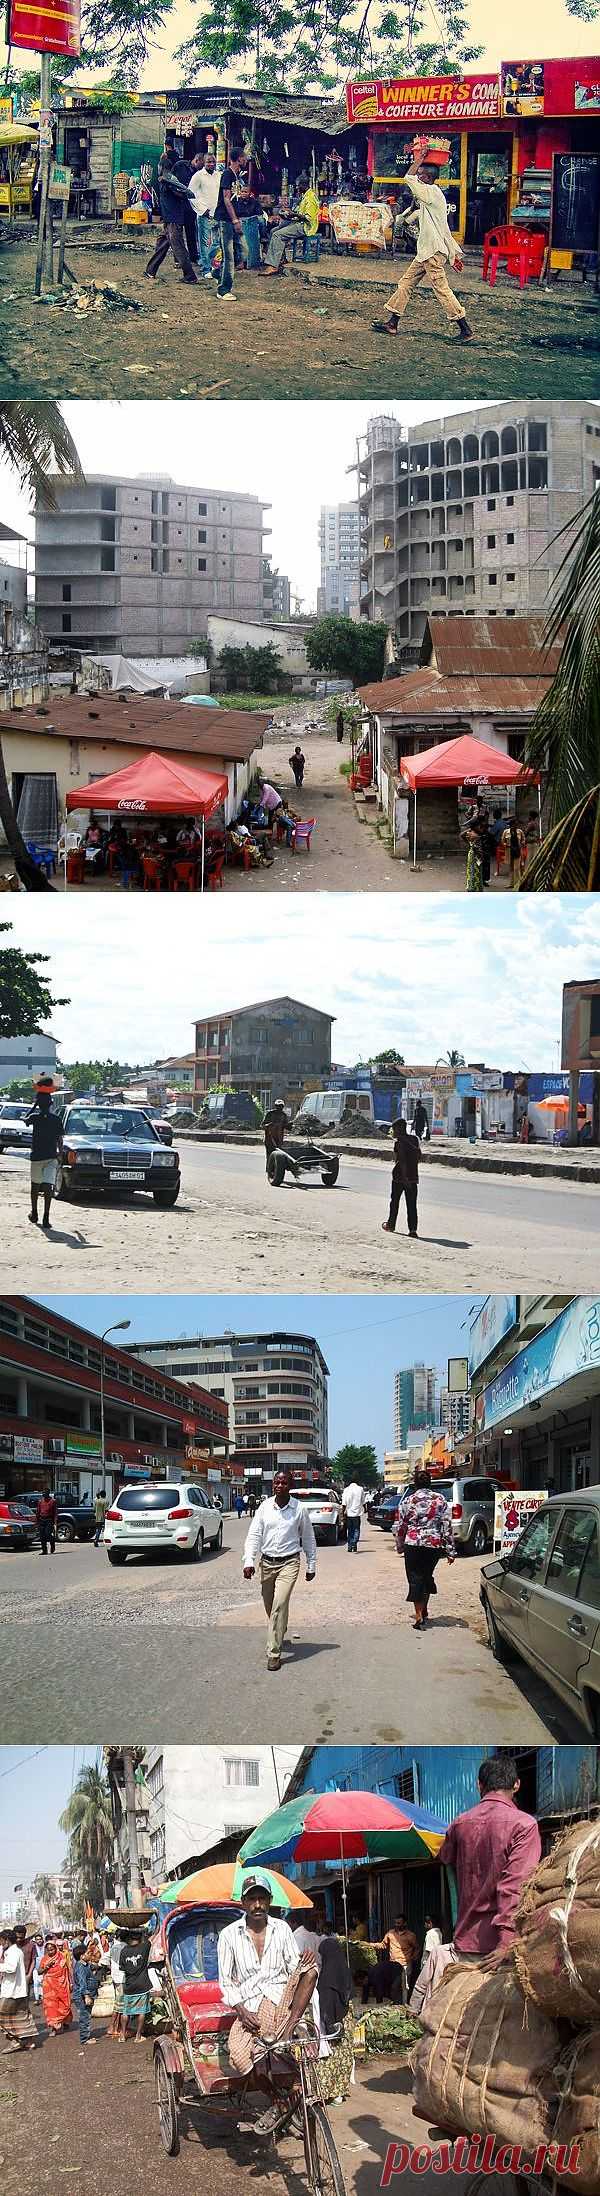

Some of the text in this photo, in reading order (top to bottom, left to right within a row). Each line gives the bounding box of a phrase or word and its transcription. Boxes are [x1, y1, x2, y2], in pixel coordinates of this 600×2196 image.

[353, 86, 375, 95] celtel
[382, 83, 470, 103] WINNER'S
[385, 104, 445, 117] COIFFURE
[446, 101, 497, 116] HOMME
[543, 1080, 562, 1089] ESPACE
[502, 1500, 525, 1511] VENTE
